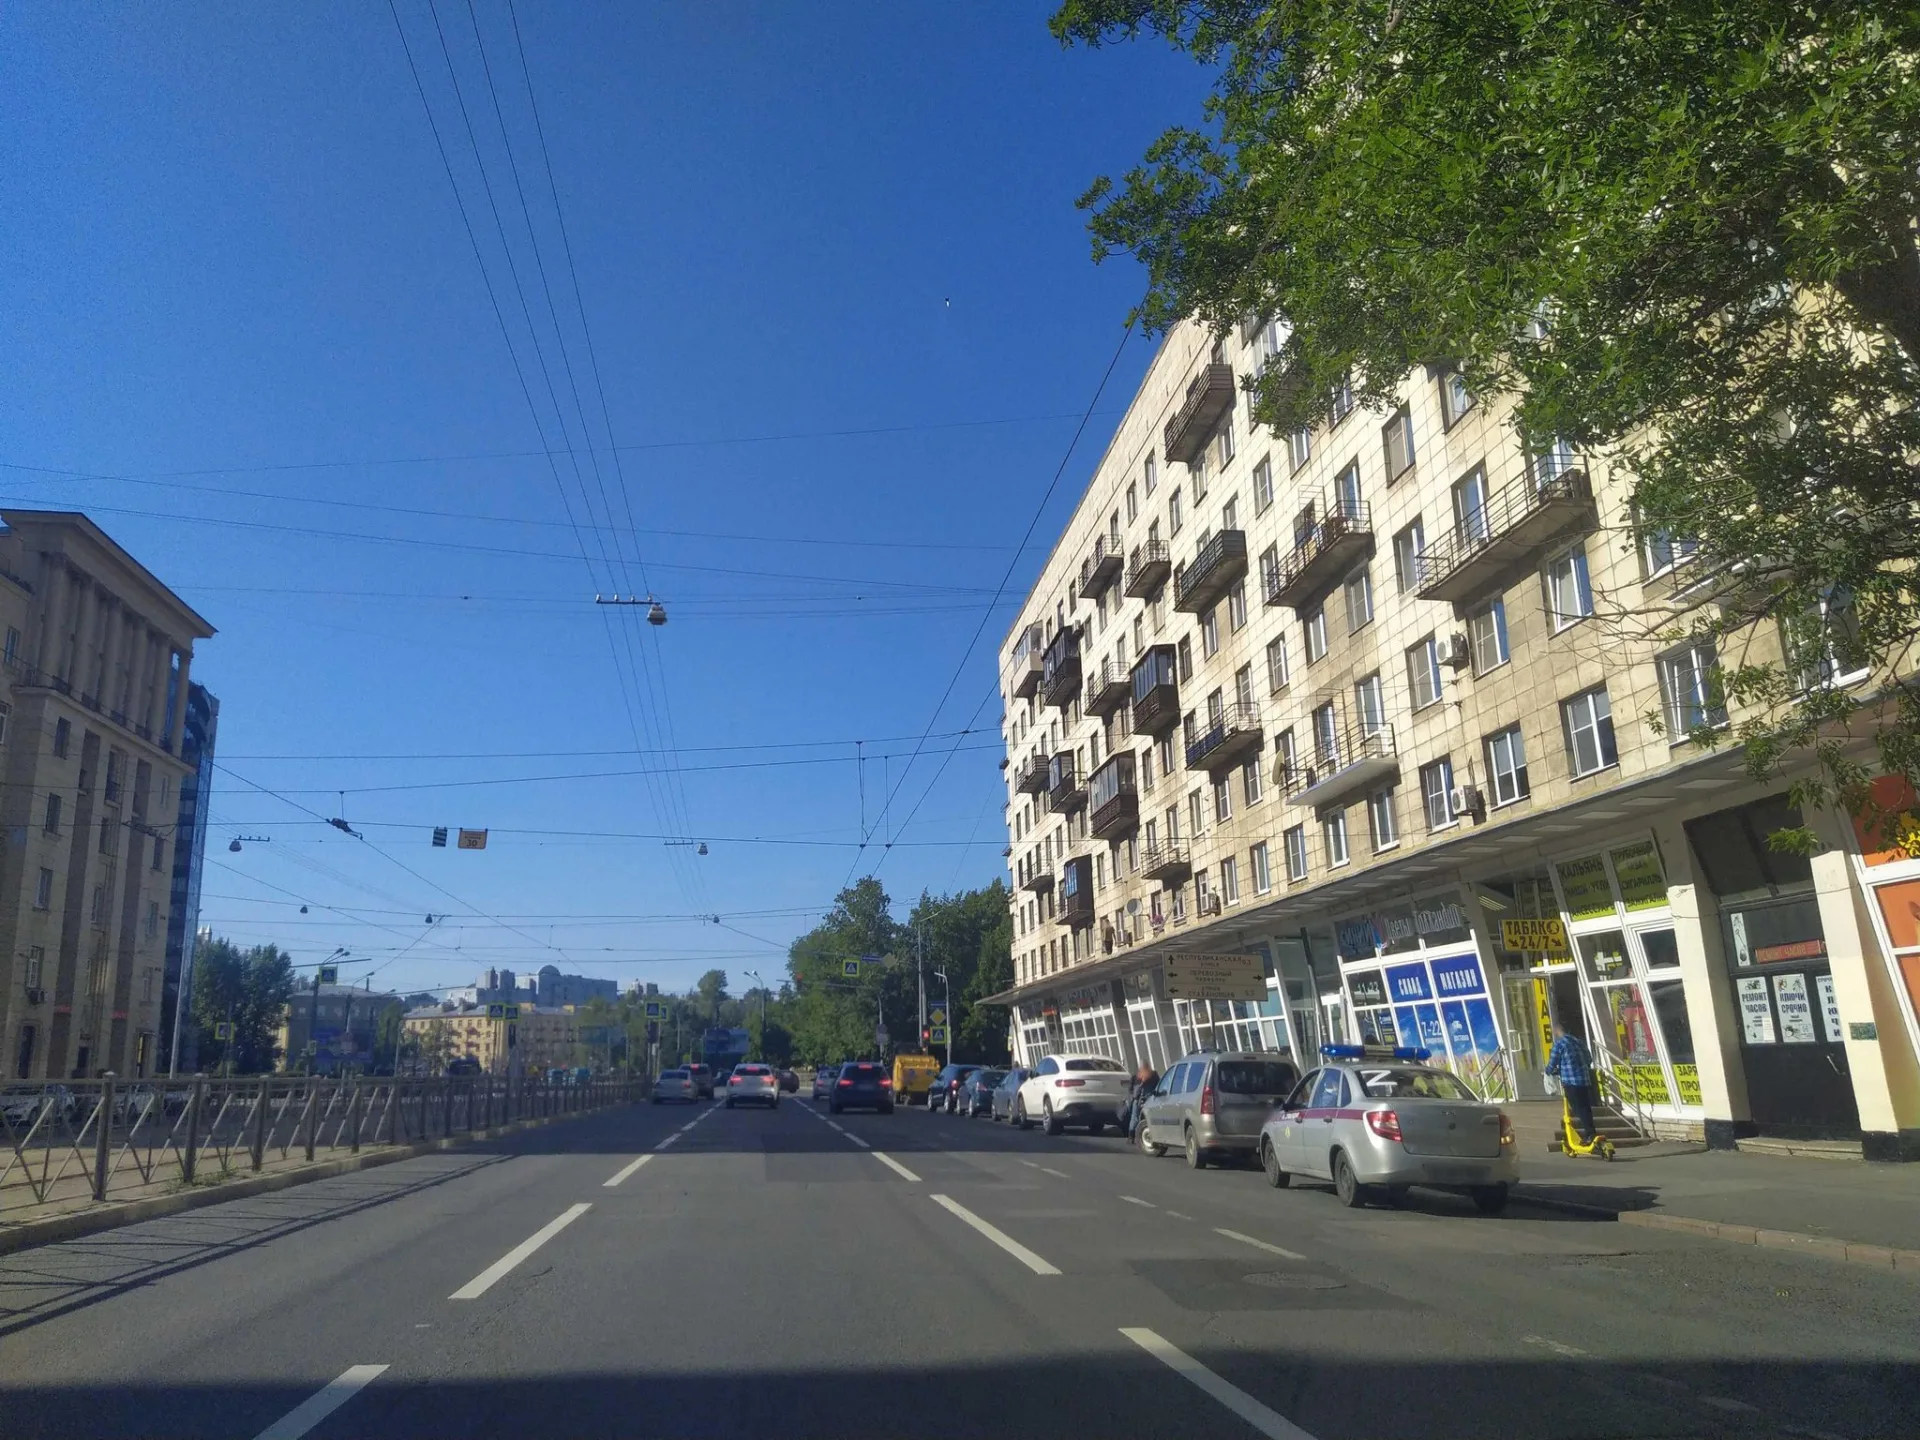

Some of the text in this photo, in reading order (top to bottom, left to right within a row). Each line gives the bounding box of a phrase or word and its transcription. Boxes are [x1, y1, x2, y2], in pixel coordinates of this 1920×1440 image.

[1520, 936, 1549, 949] 24/7
[1440, 968, 1478, 990] МАГАЗИН
[1398, 977, 1423, 996] СКЛАД
[1742, 992, 1767, 1002] РЕМОНТ
[1779, 992, 1805, 1001] КЛЮЧИ
[1535, 977, 1554, 1050] ТАБ
[1745, 1003, 1767, 1013] ЧАСОВ
[1781, 1003, 1807, 1013] СРОЧНО
[1680, 1080, 1700, 1092] ПРО
